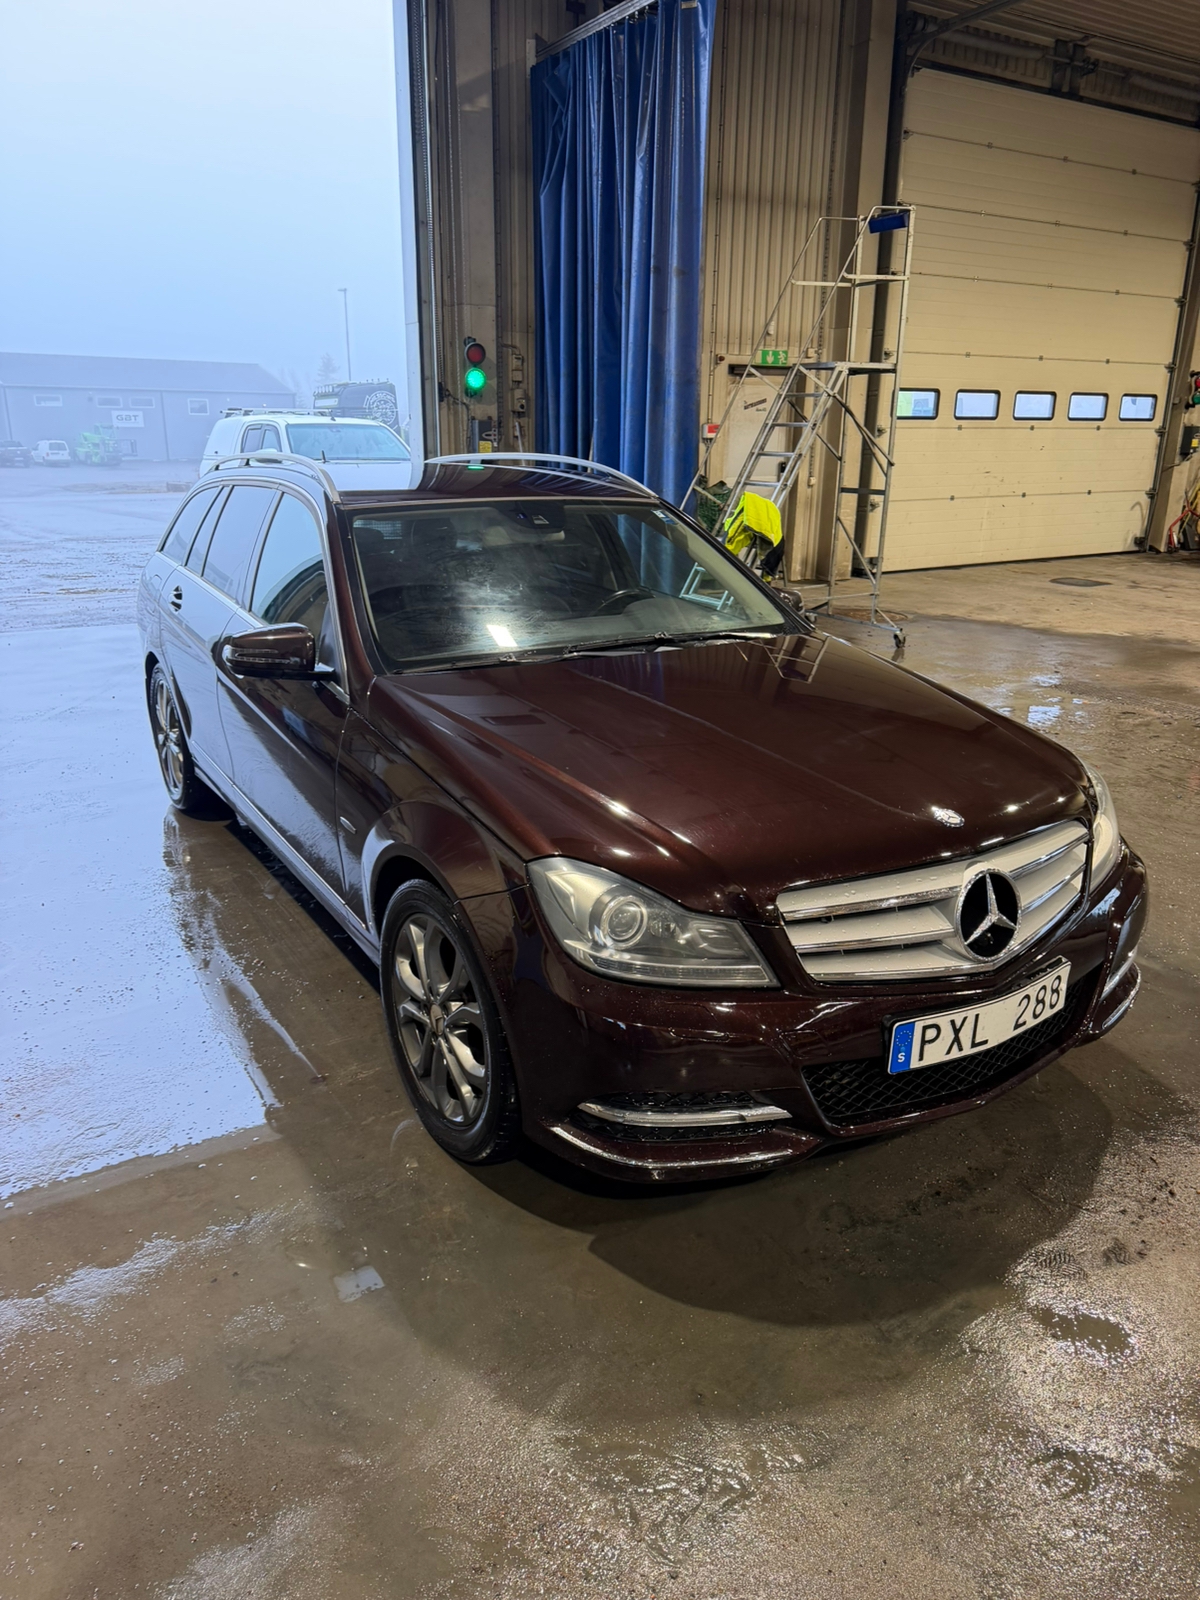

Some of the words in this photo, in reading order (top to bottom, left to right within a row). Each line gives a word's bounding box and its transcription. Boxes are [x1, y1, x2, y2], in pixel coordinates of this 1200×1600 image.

[918, 1013, 988, 1061] PXL
[1013, 975, 1062, 1031] 288
[897, 1052, 905, 1062] S
